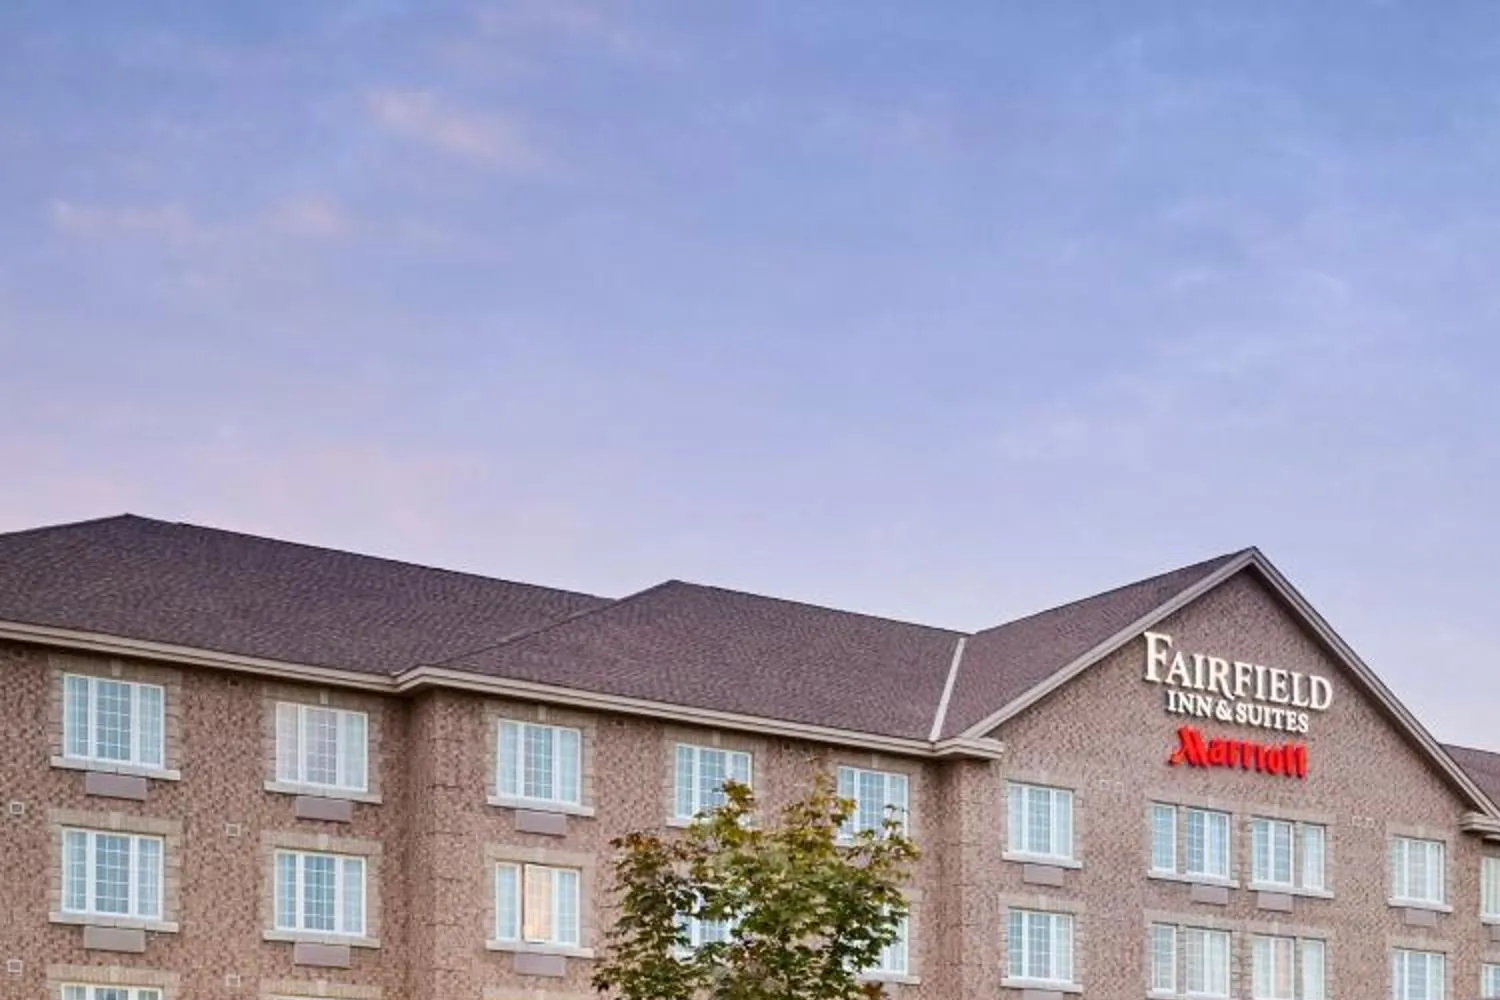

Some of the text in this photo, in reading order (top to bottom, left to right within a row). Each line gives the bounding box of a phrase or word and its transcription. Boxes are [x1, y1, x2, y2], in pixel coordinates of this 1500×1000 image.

[1143, 631, 1333, 710] FAIRFIELD
[1166, 689, 1309, 733] INN & SUITES
[1169, 726, 1309, 778] Marriott
